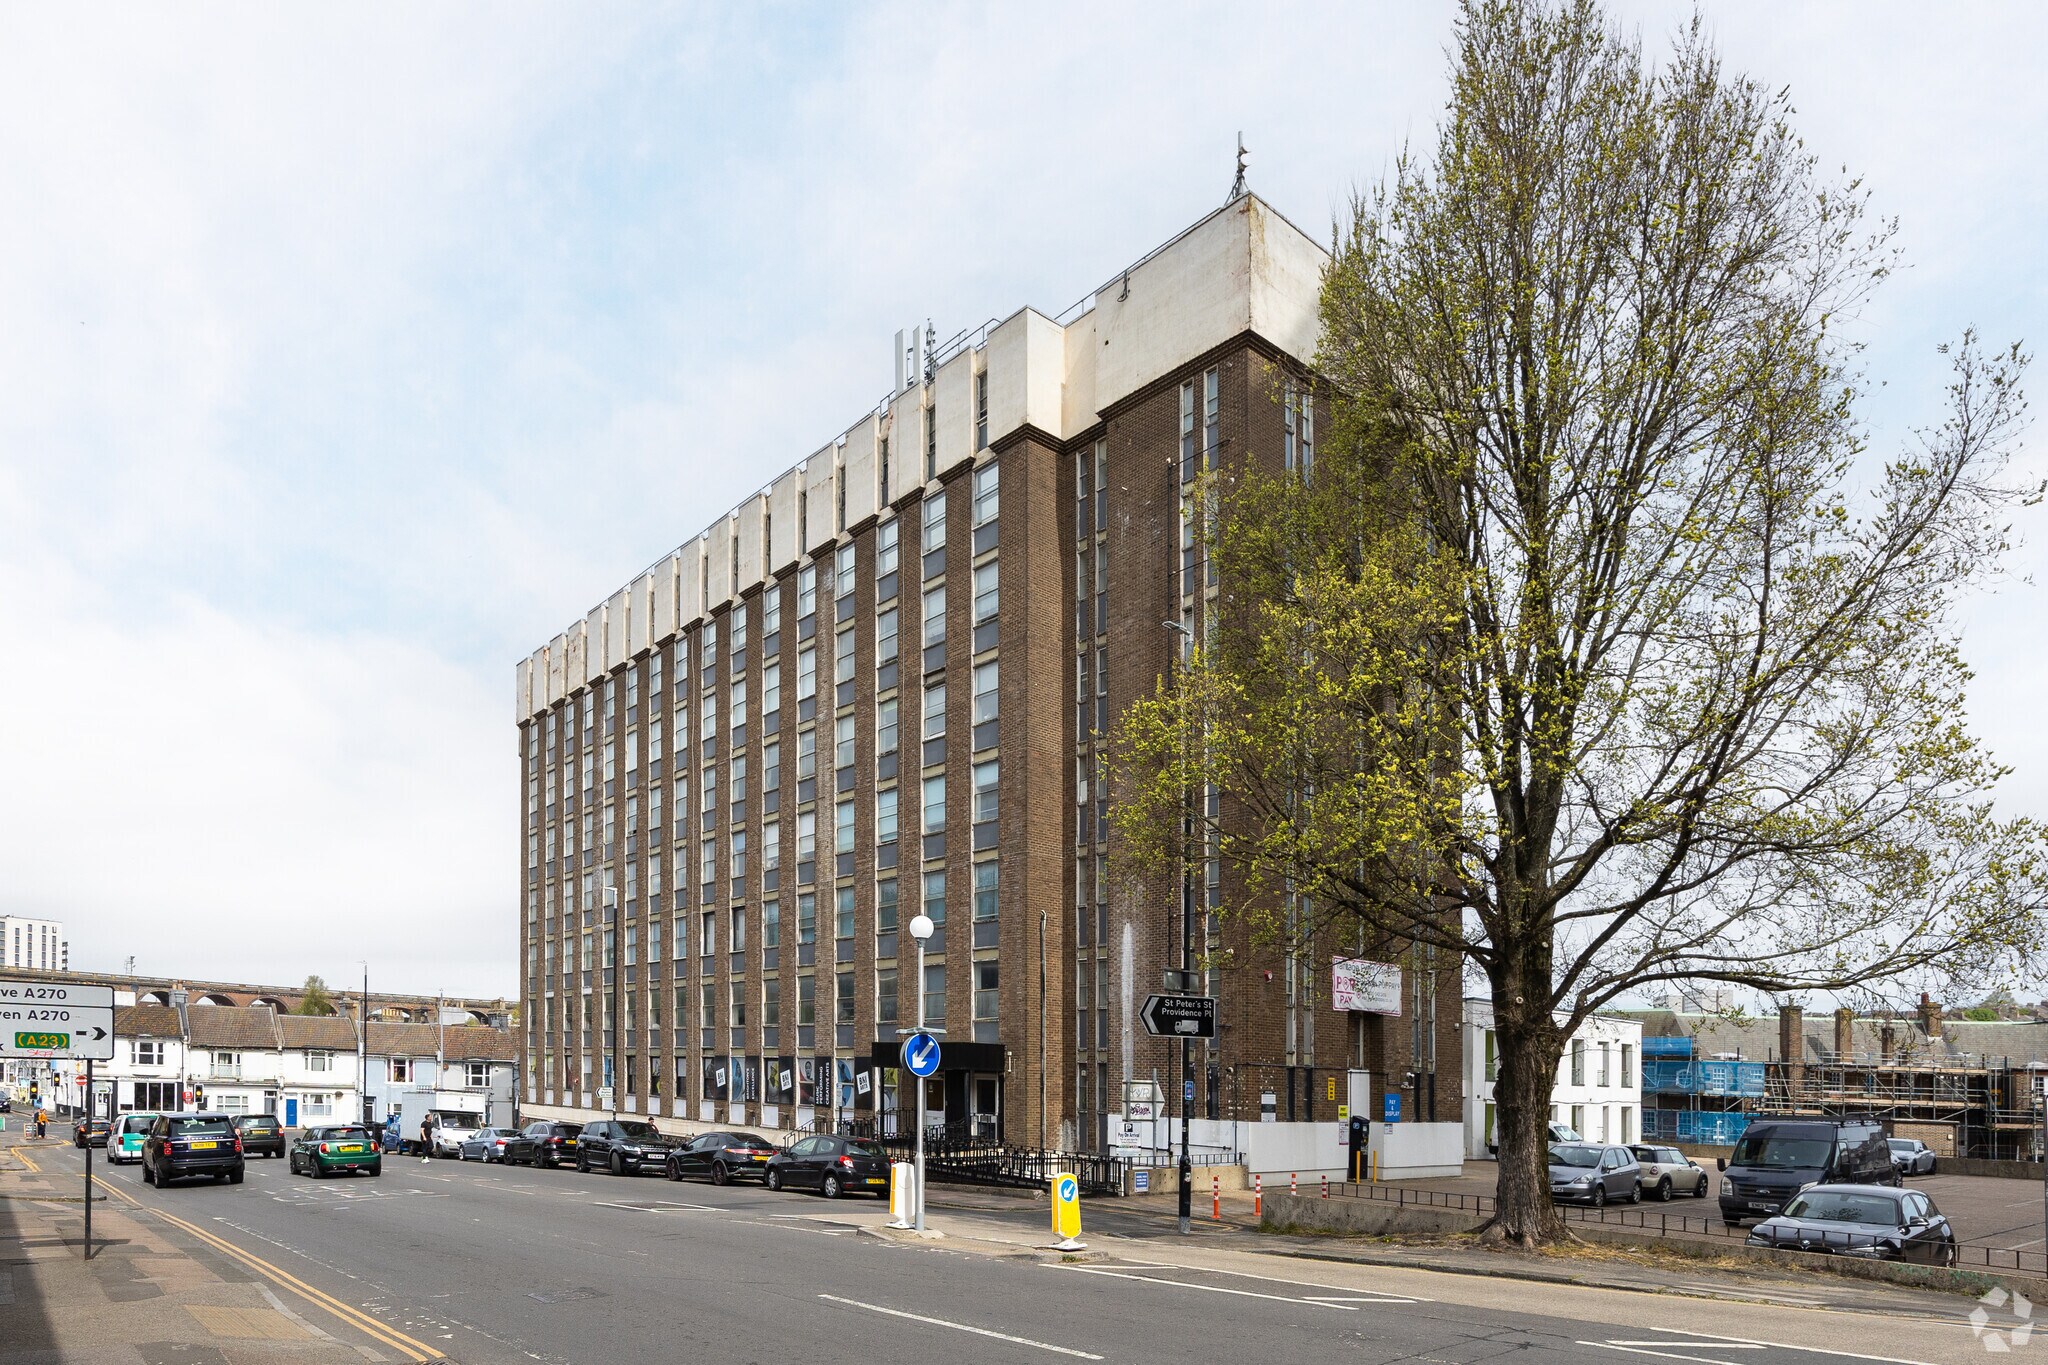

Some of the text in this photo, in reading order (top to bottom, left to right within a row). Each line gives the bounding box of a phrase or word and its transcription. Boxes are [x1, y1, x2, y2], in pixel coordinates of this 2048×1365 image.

[24, 988, 67, 1000] A270
[1164, 999, 1212, 1009] St Peter's St
[1340, 995, 1352, 1005] PAY
[0, 1009, 70, 1021] en A270
[1161, 1007, 1212, 1018] Providence Pl
